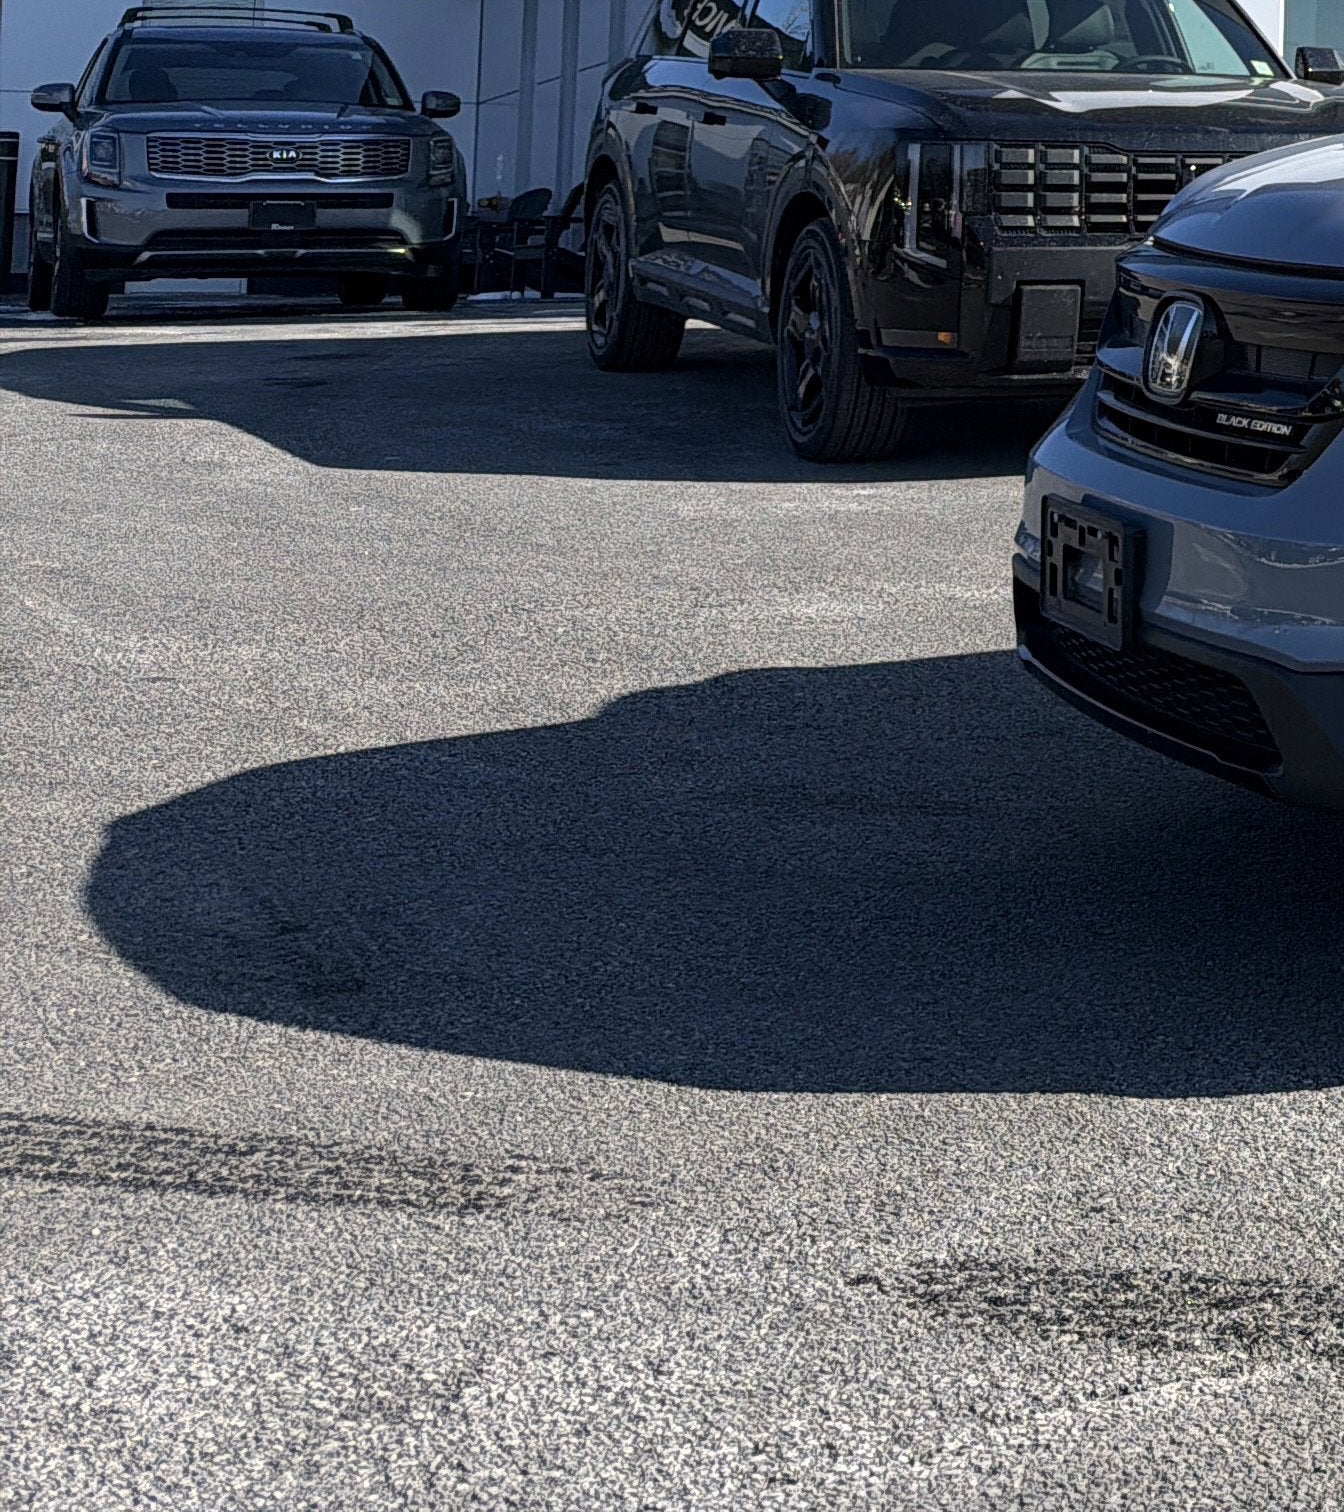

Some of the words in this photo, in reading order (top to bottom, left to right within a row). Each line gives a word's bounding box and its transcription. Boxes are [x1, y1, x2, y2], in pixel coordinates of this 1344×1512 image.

[272, 149, 297, 160] KIA
[1215, 413, 1251, 428] BLACK
[1249, 419, 1293, 436] EDITION
